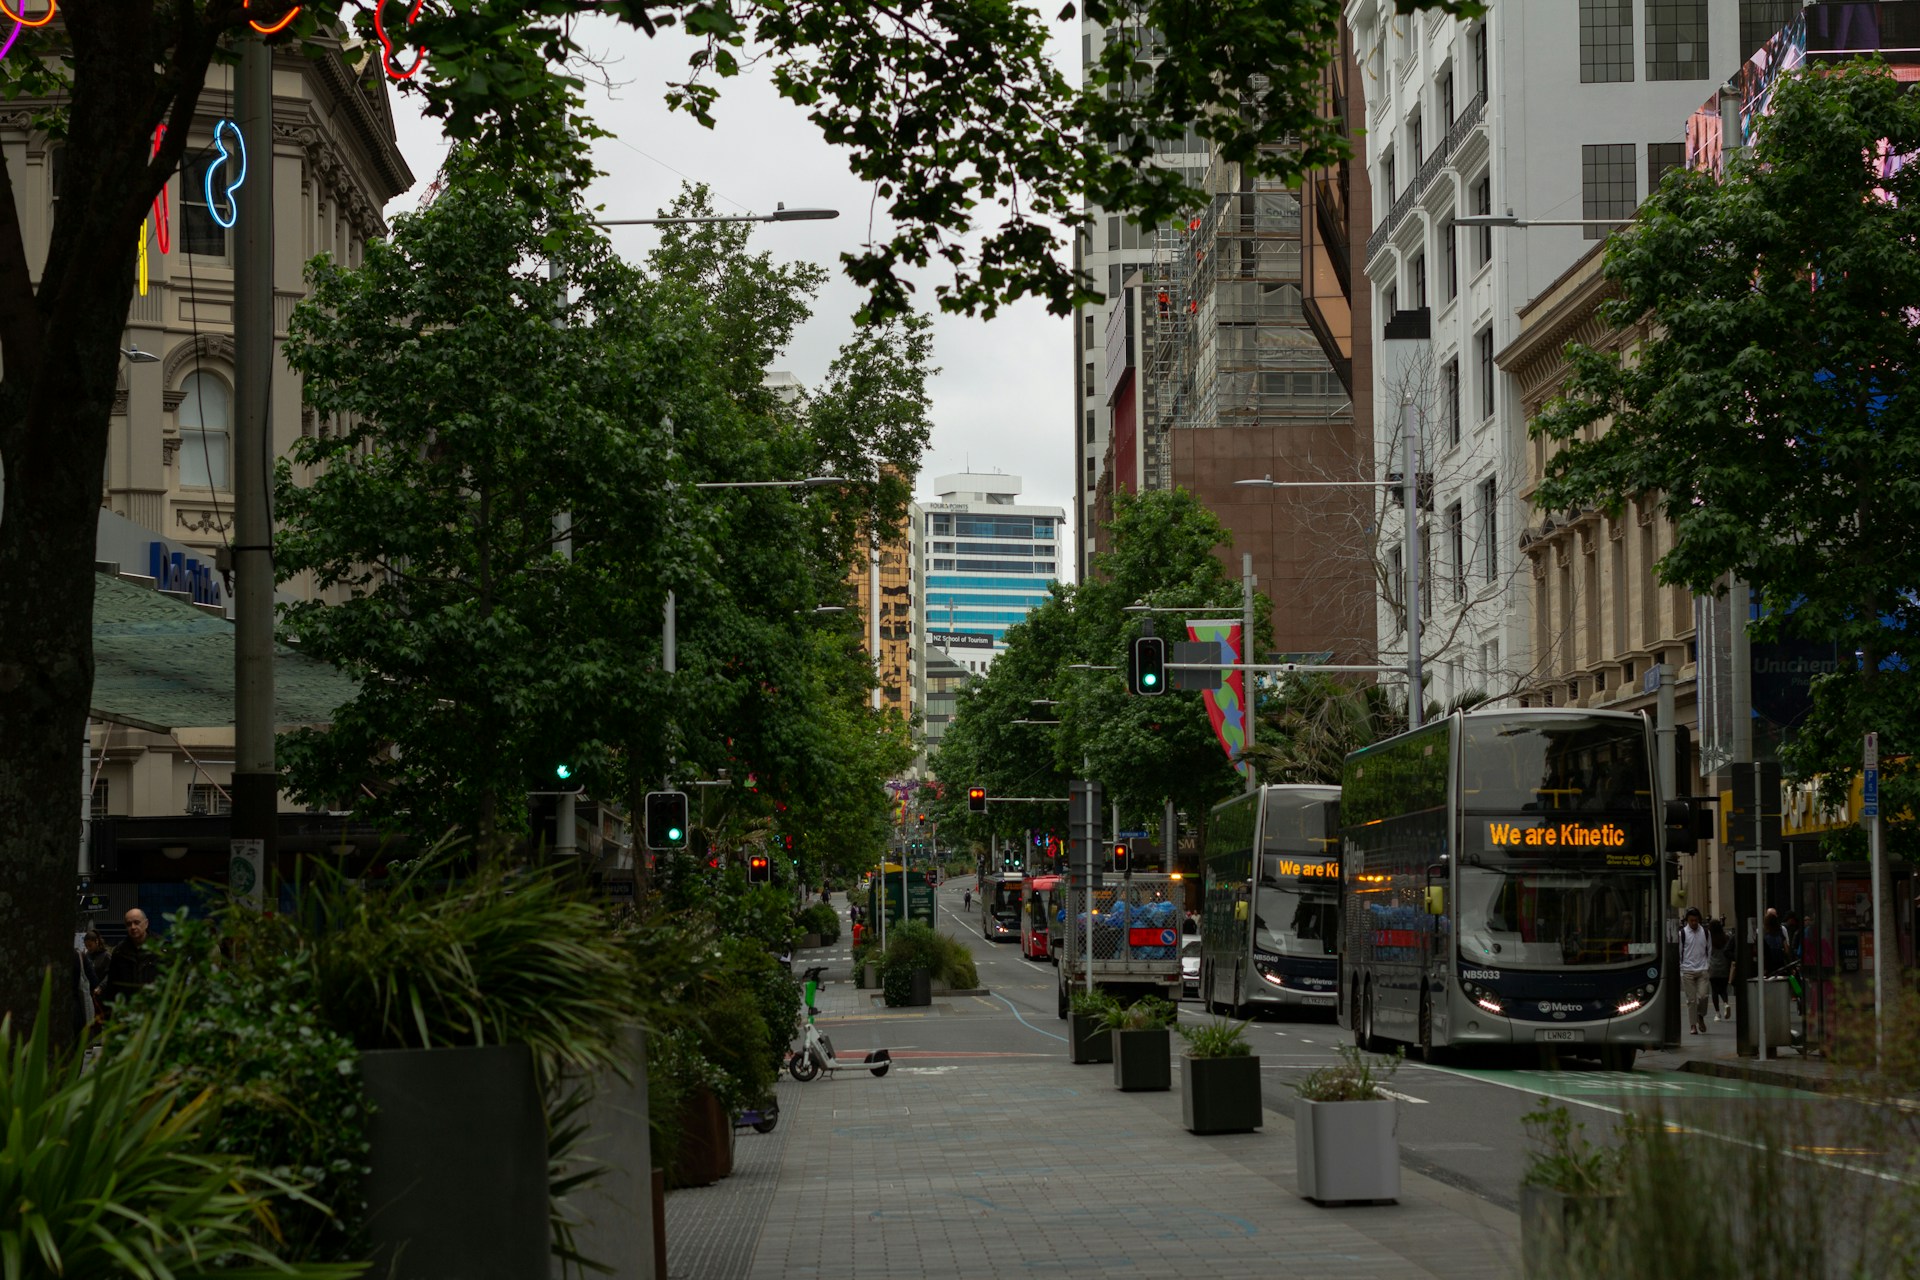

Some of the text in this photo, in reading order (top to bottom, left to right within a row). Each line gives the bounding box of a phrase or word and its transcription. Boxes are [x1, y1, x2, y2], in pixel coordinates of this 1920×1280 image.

[943, 635, 960, 643] School
[968, 636, 989, 644] Tourism
[1490, 823, 1625, 846] We are Kinetic
[1279, 860, 1301, 875] We
[1302, 864, 1325, 877] are
[1462, 969, 1500, 980] NB5033
[1311, 977, 1333, 986] Metro
[1551, 1002, 1583, 1011] Metro
[1547, 1031, 1572, 1040] LWN82
